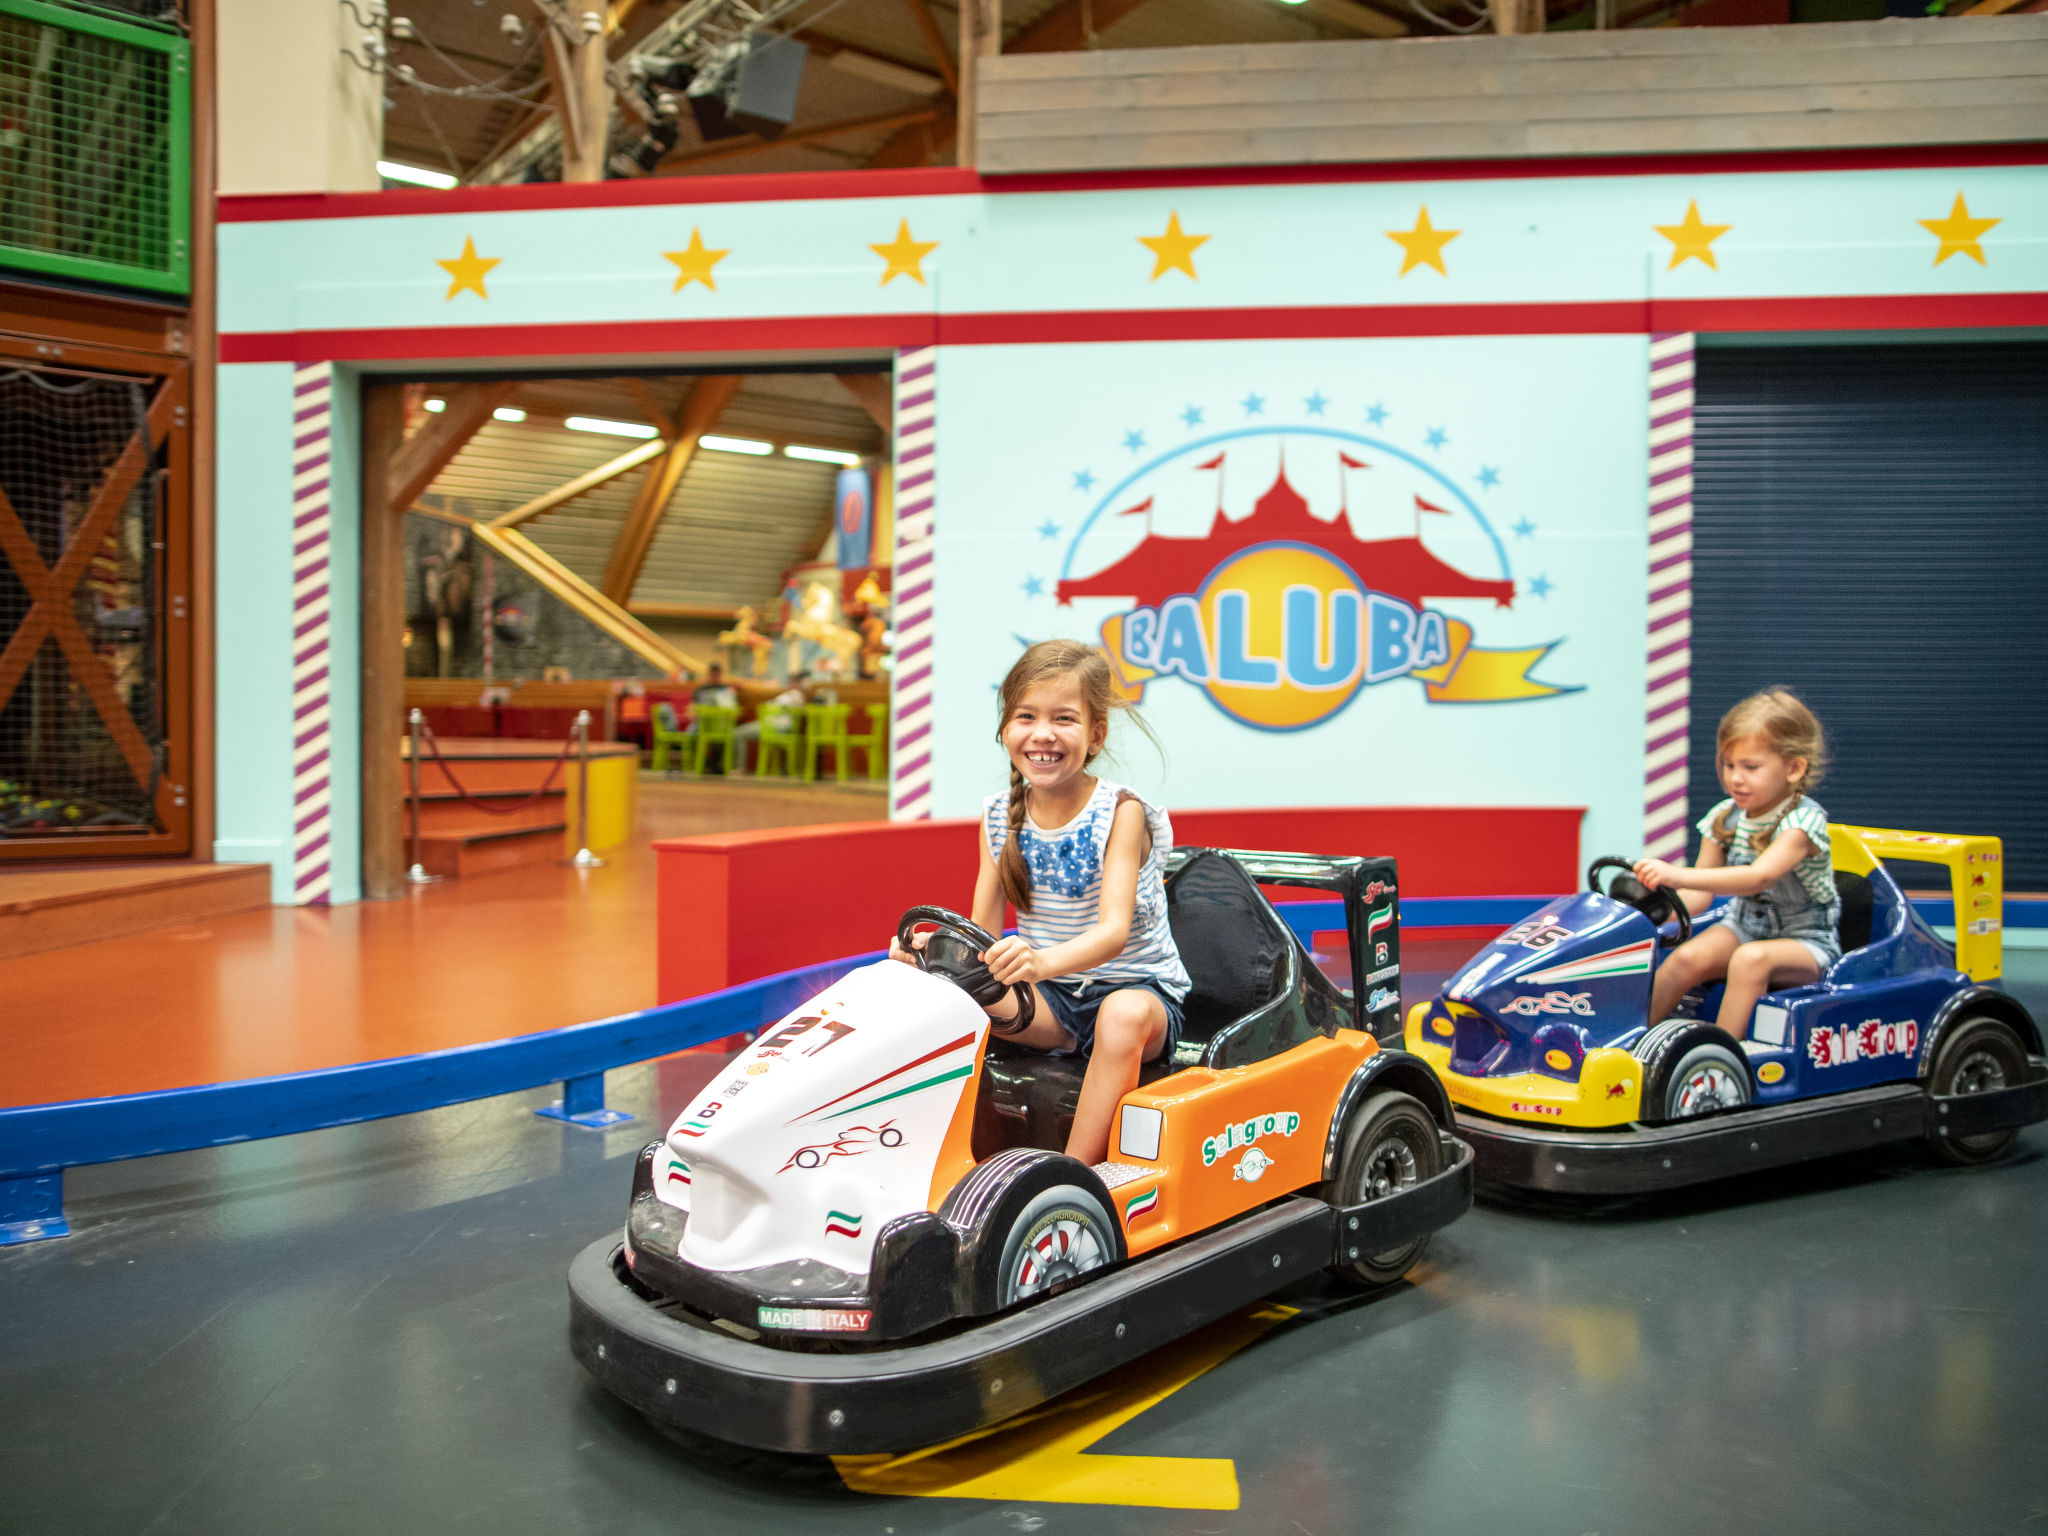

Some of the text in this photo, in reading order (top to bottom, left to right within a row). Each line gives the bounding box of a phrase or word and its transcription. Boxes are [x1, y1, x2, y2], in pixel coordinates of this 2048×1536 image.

[1122, 585, 1451, 691] BALUBA
[758, 1016, 857, 1057] 27
[1203, 1112, 1299, 1166] Selagroup
[760, 1310, 801, 1326] MADE
[826, 1313, 868, 1328] ITALY
